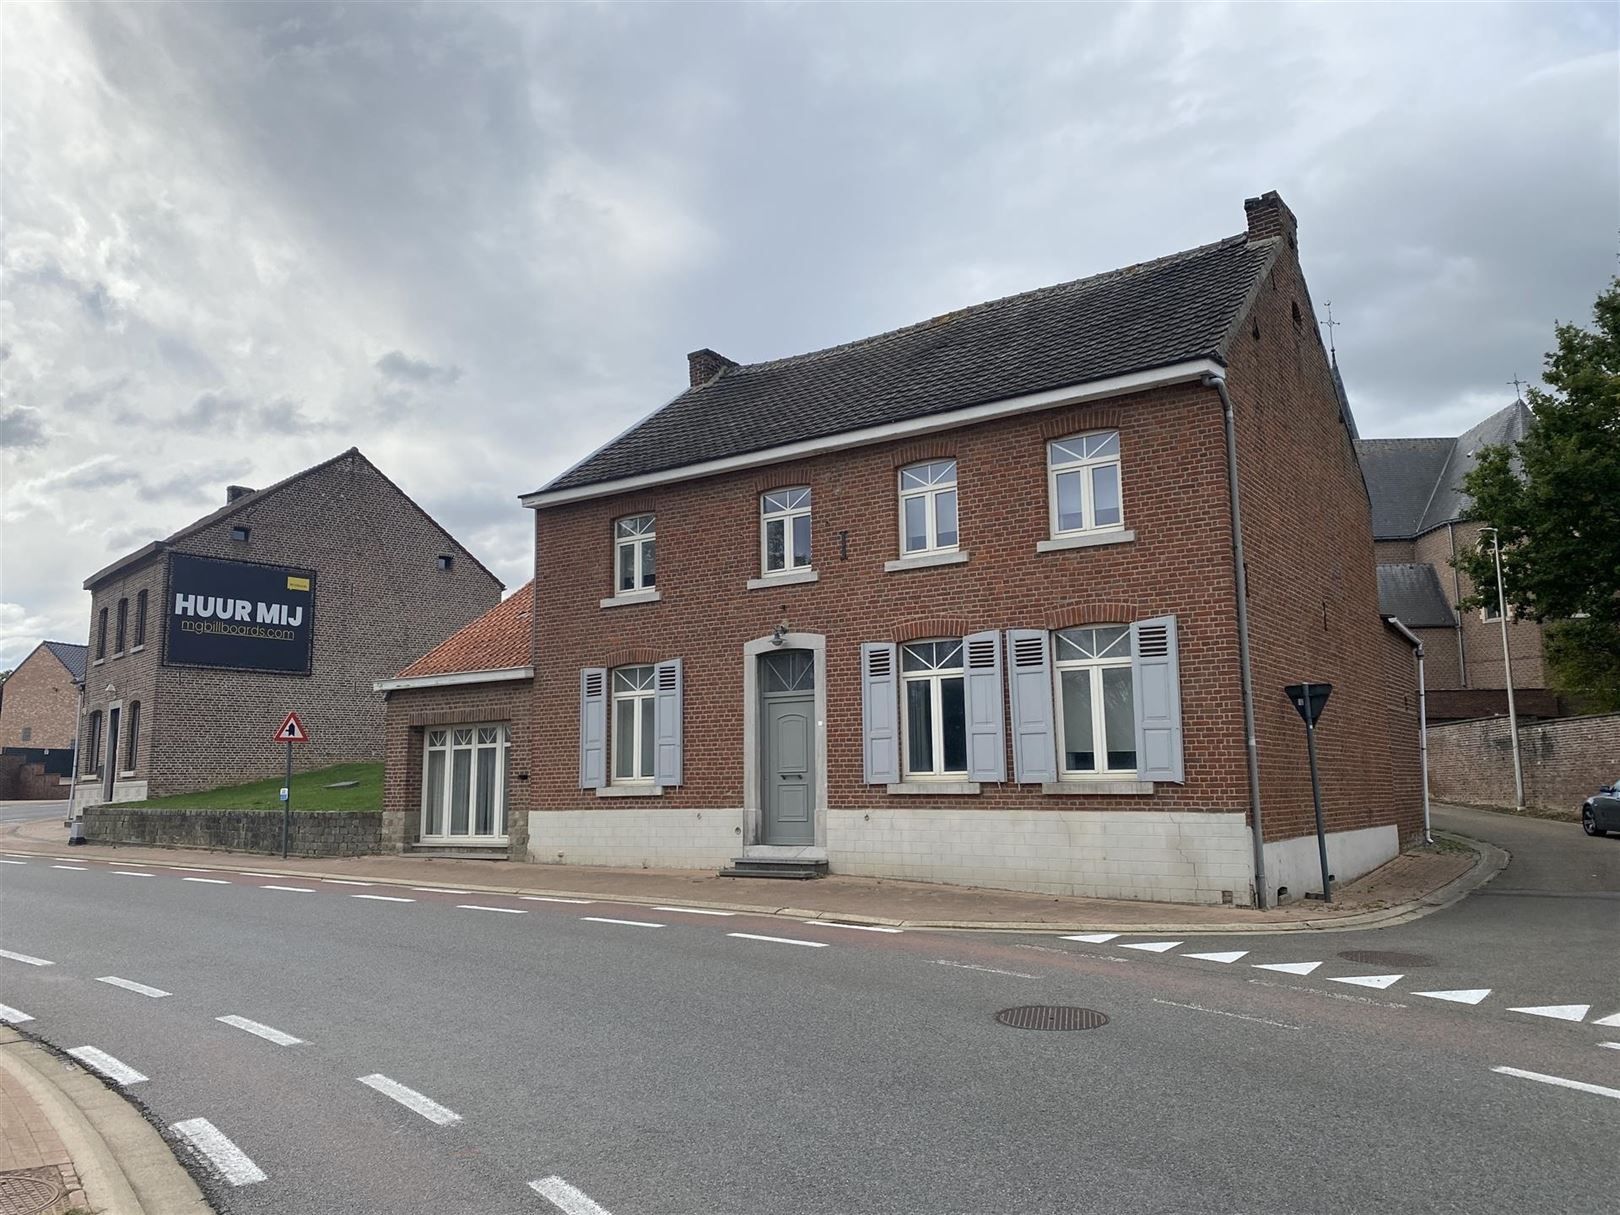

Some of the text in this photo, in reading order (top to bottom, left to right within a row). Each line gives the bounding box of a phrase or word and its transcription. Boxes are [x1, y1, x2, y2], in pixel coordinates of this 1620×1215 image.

[175, 593, 303, 626] HUUR MIJ
[181, 620, 295, 640] mgbillboards.com
